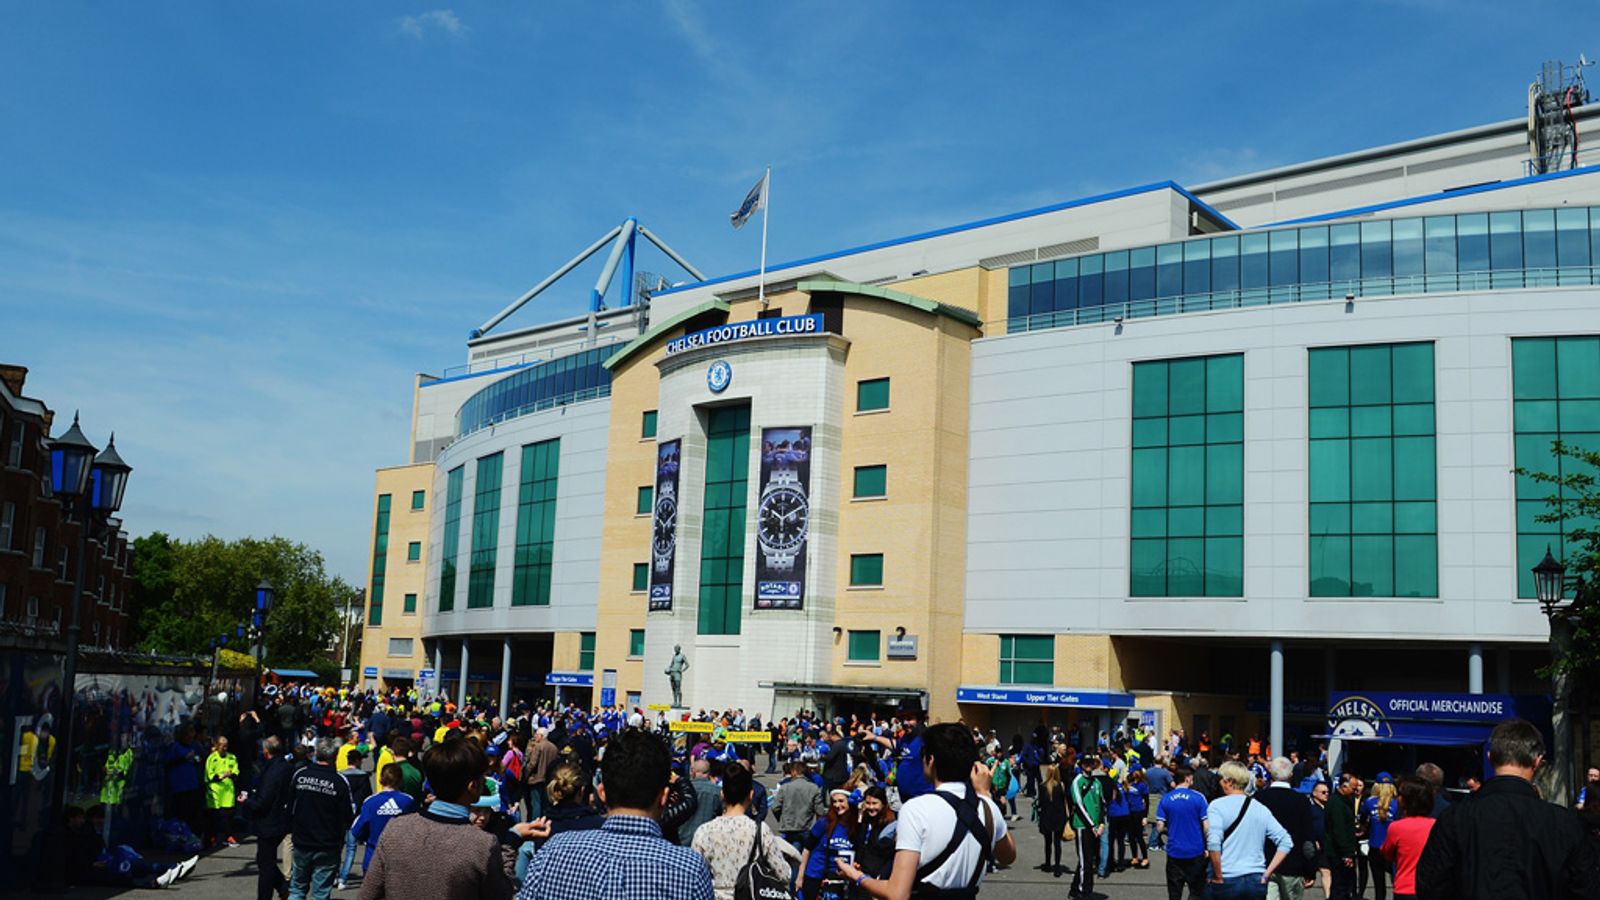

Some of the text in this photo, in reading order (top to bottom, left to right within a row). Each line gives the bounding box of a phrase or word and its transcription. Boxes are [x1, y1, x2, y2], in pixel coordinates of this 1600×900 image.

[666, 317, 815, 354] CHELSEA FOOTBALL CLUB
[976, 692, 1079, 703] West Stand Upper Tier Gates
[1389, 698, 1504, 715] OFFICIAL MERCHANDISE
[1328, 702, 1379, 730] CHELSEA
[671, 722, 712, 731] Programmes
[728, 732, 769, 741] Programmes
[297, 776, 334, 790] CHELSEA
[376, 808, 403, 816] adidas
